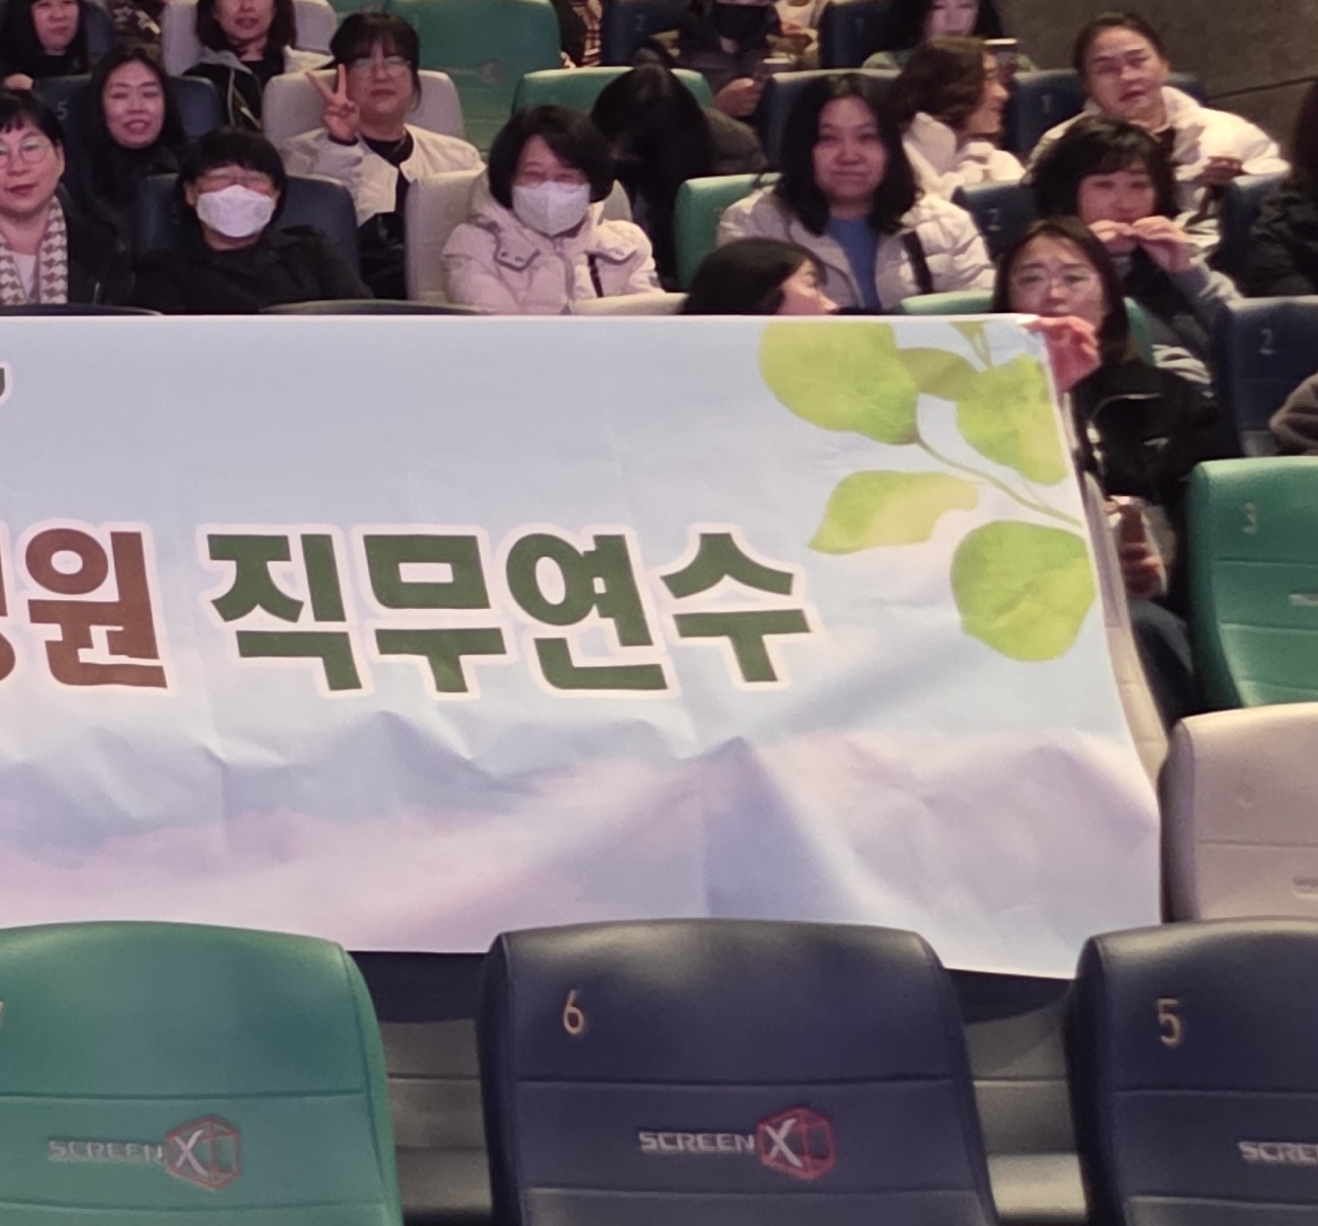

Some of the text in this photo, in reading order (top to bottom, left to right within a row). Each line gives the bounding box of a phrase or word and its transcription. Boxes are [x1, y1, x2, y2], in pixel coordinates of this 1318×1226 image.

[986, 207, 1001, 232] 2
[1258, 327, 1276, 356] 2
[1242, 500, 1259, 537] 3
[205, 531, 813, 694] 직무연수
[562, 989, 586, 1035] 6
[1156, 997, 1183, 1048] 5
[1238, 1140, 1318, 1165] SCRE
